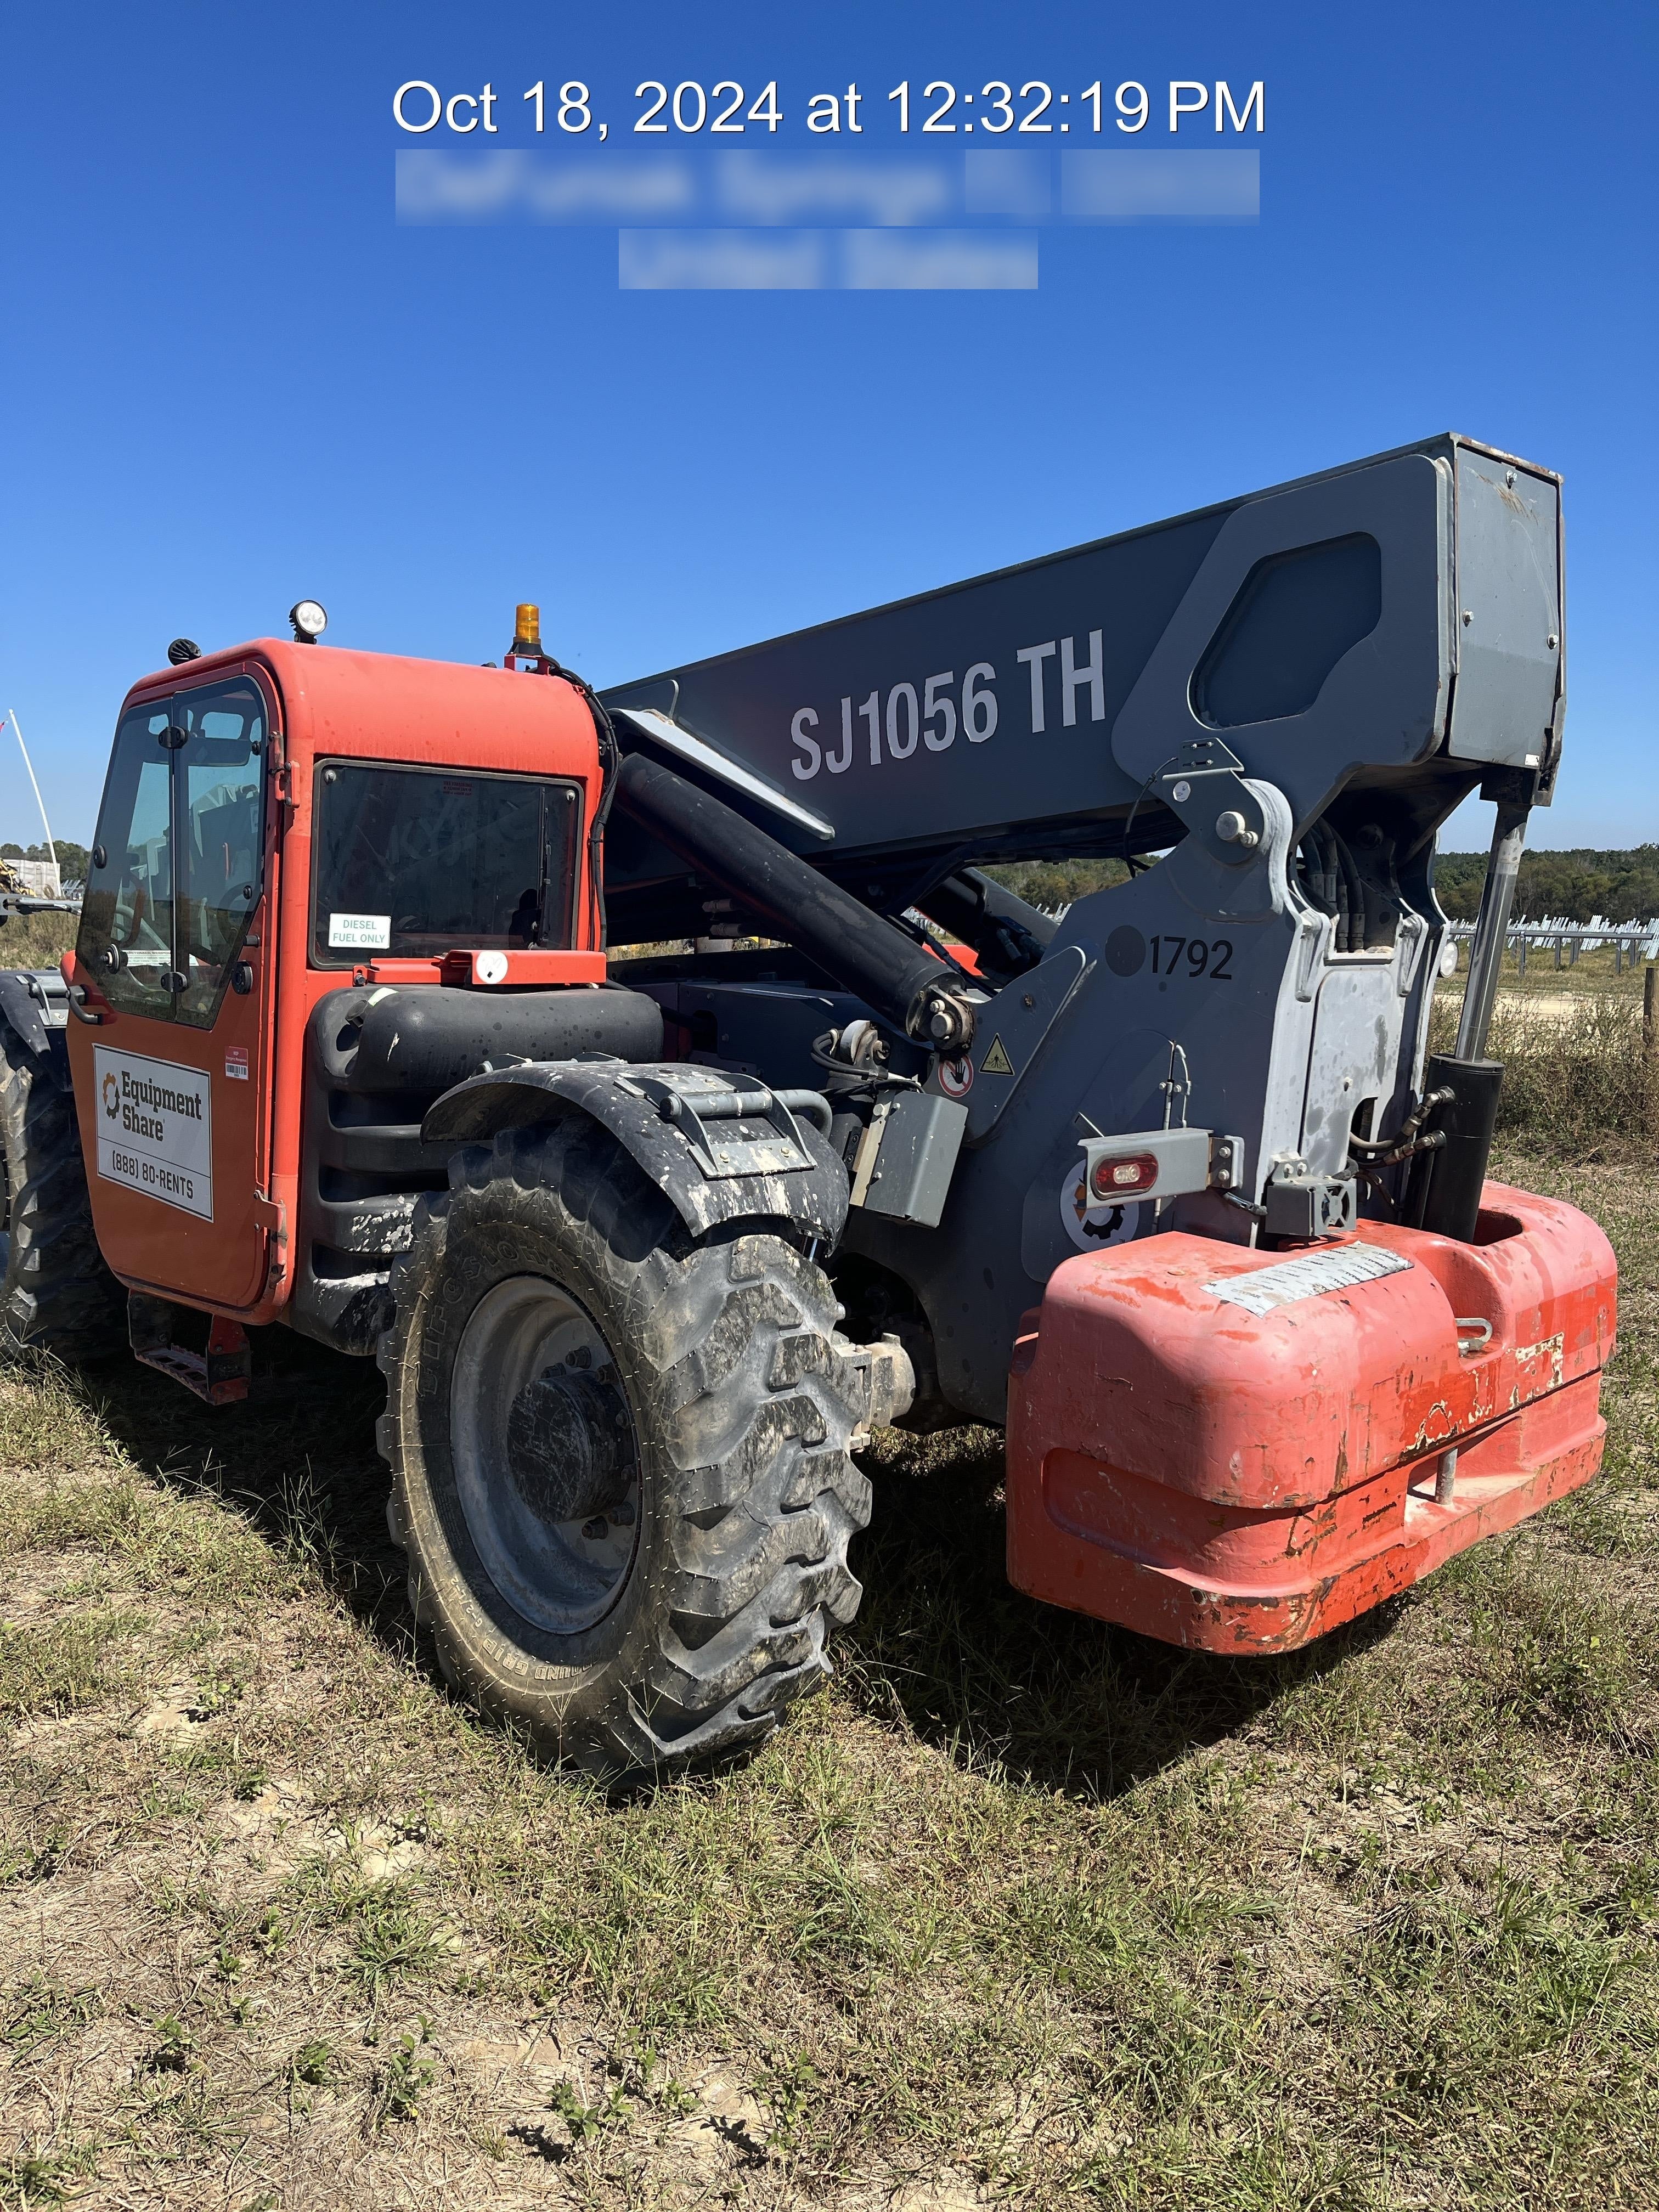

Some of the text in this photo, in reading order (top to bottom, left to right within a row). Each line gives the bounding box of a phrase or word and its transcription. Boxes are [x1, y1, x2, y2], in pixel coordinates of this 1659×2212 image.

[791, 629, 1105, 780] SJ1056 TH
[333, 933, 386, 943] FUEL ONLY
[343, 919, 377, 930] DIESEL
[1150, 935, 1233, 980] 1792
[122, 1070, 202, 1120] Equipment
[122, 1103, 164, 1142] Share
[112, 1150, 194, 1199] (888) 80-RENTS
[483, 1638, 529, 1677] GRIP
